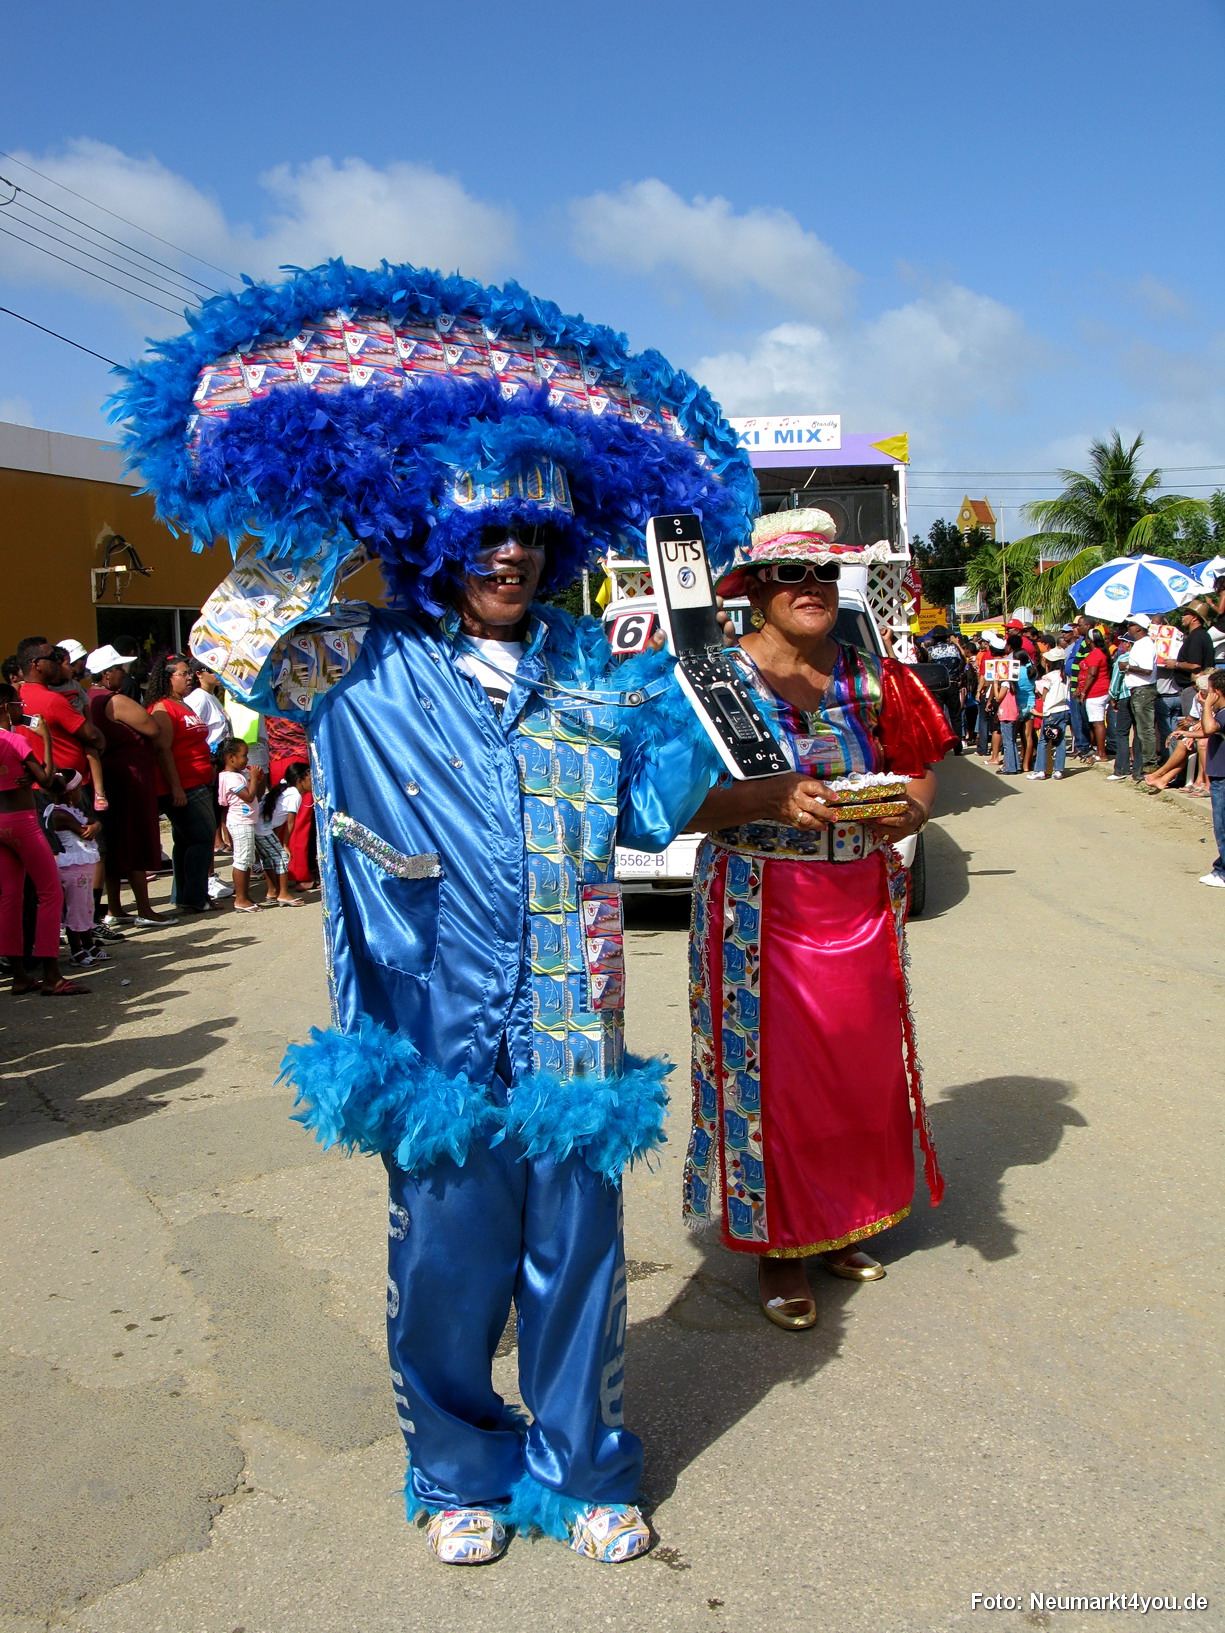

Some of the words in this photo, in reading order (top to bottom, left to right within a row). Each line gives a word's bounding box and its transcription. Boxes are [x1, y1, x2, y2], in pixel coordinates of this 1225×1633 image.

[775, 429, 822, 444] MIX
[663, 541, 701, 562] UTS
[616, 616, 645, 649] 6
[619, 854, 665, 867] 5562-B
